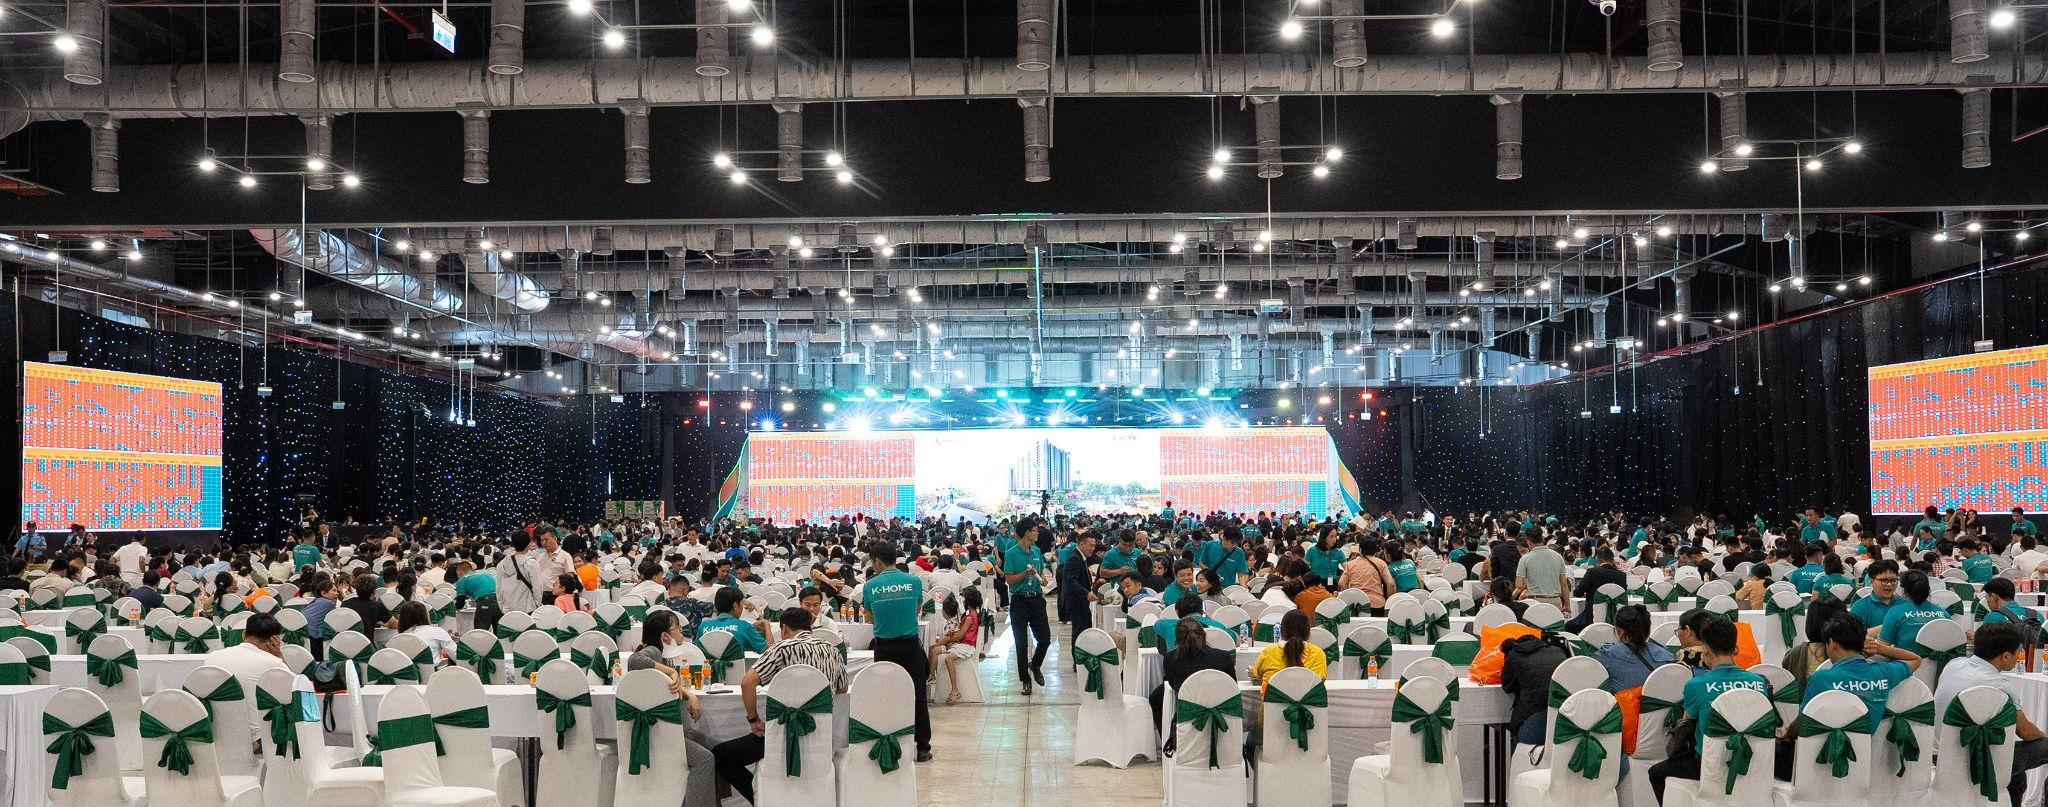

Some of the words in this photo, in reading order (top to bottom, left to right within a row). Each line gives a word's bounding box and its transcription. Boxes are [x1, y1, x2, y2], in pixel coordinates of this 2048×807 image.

[871, 583, 913, 595] K-HOME
[1904, 610, 1945, 619] K-HOME
[1705, 680, 1765, 693] K-HOME
[1832, 678, 1889, 691] K-HOME
